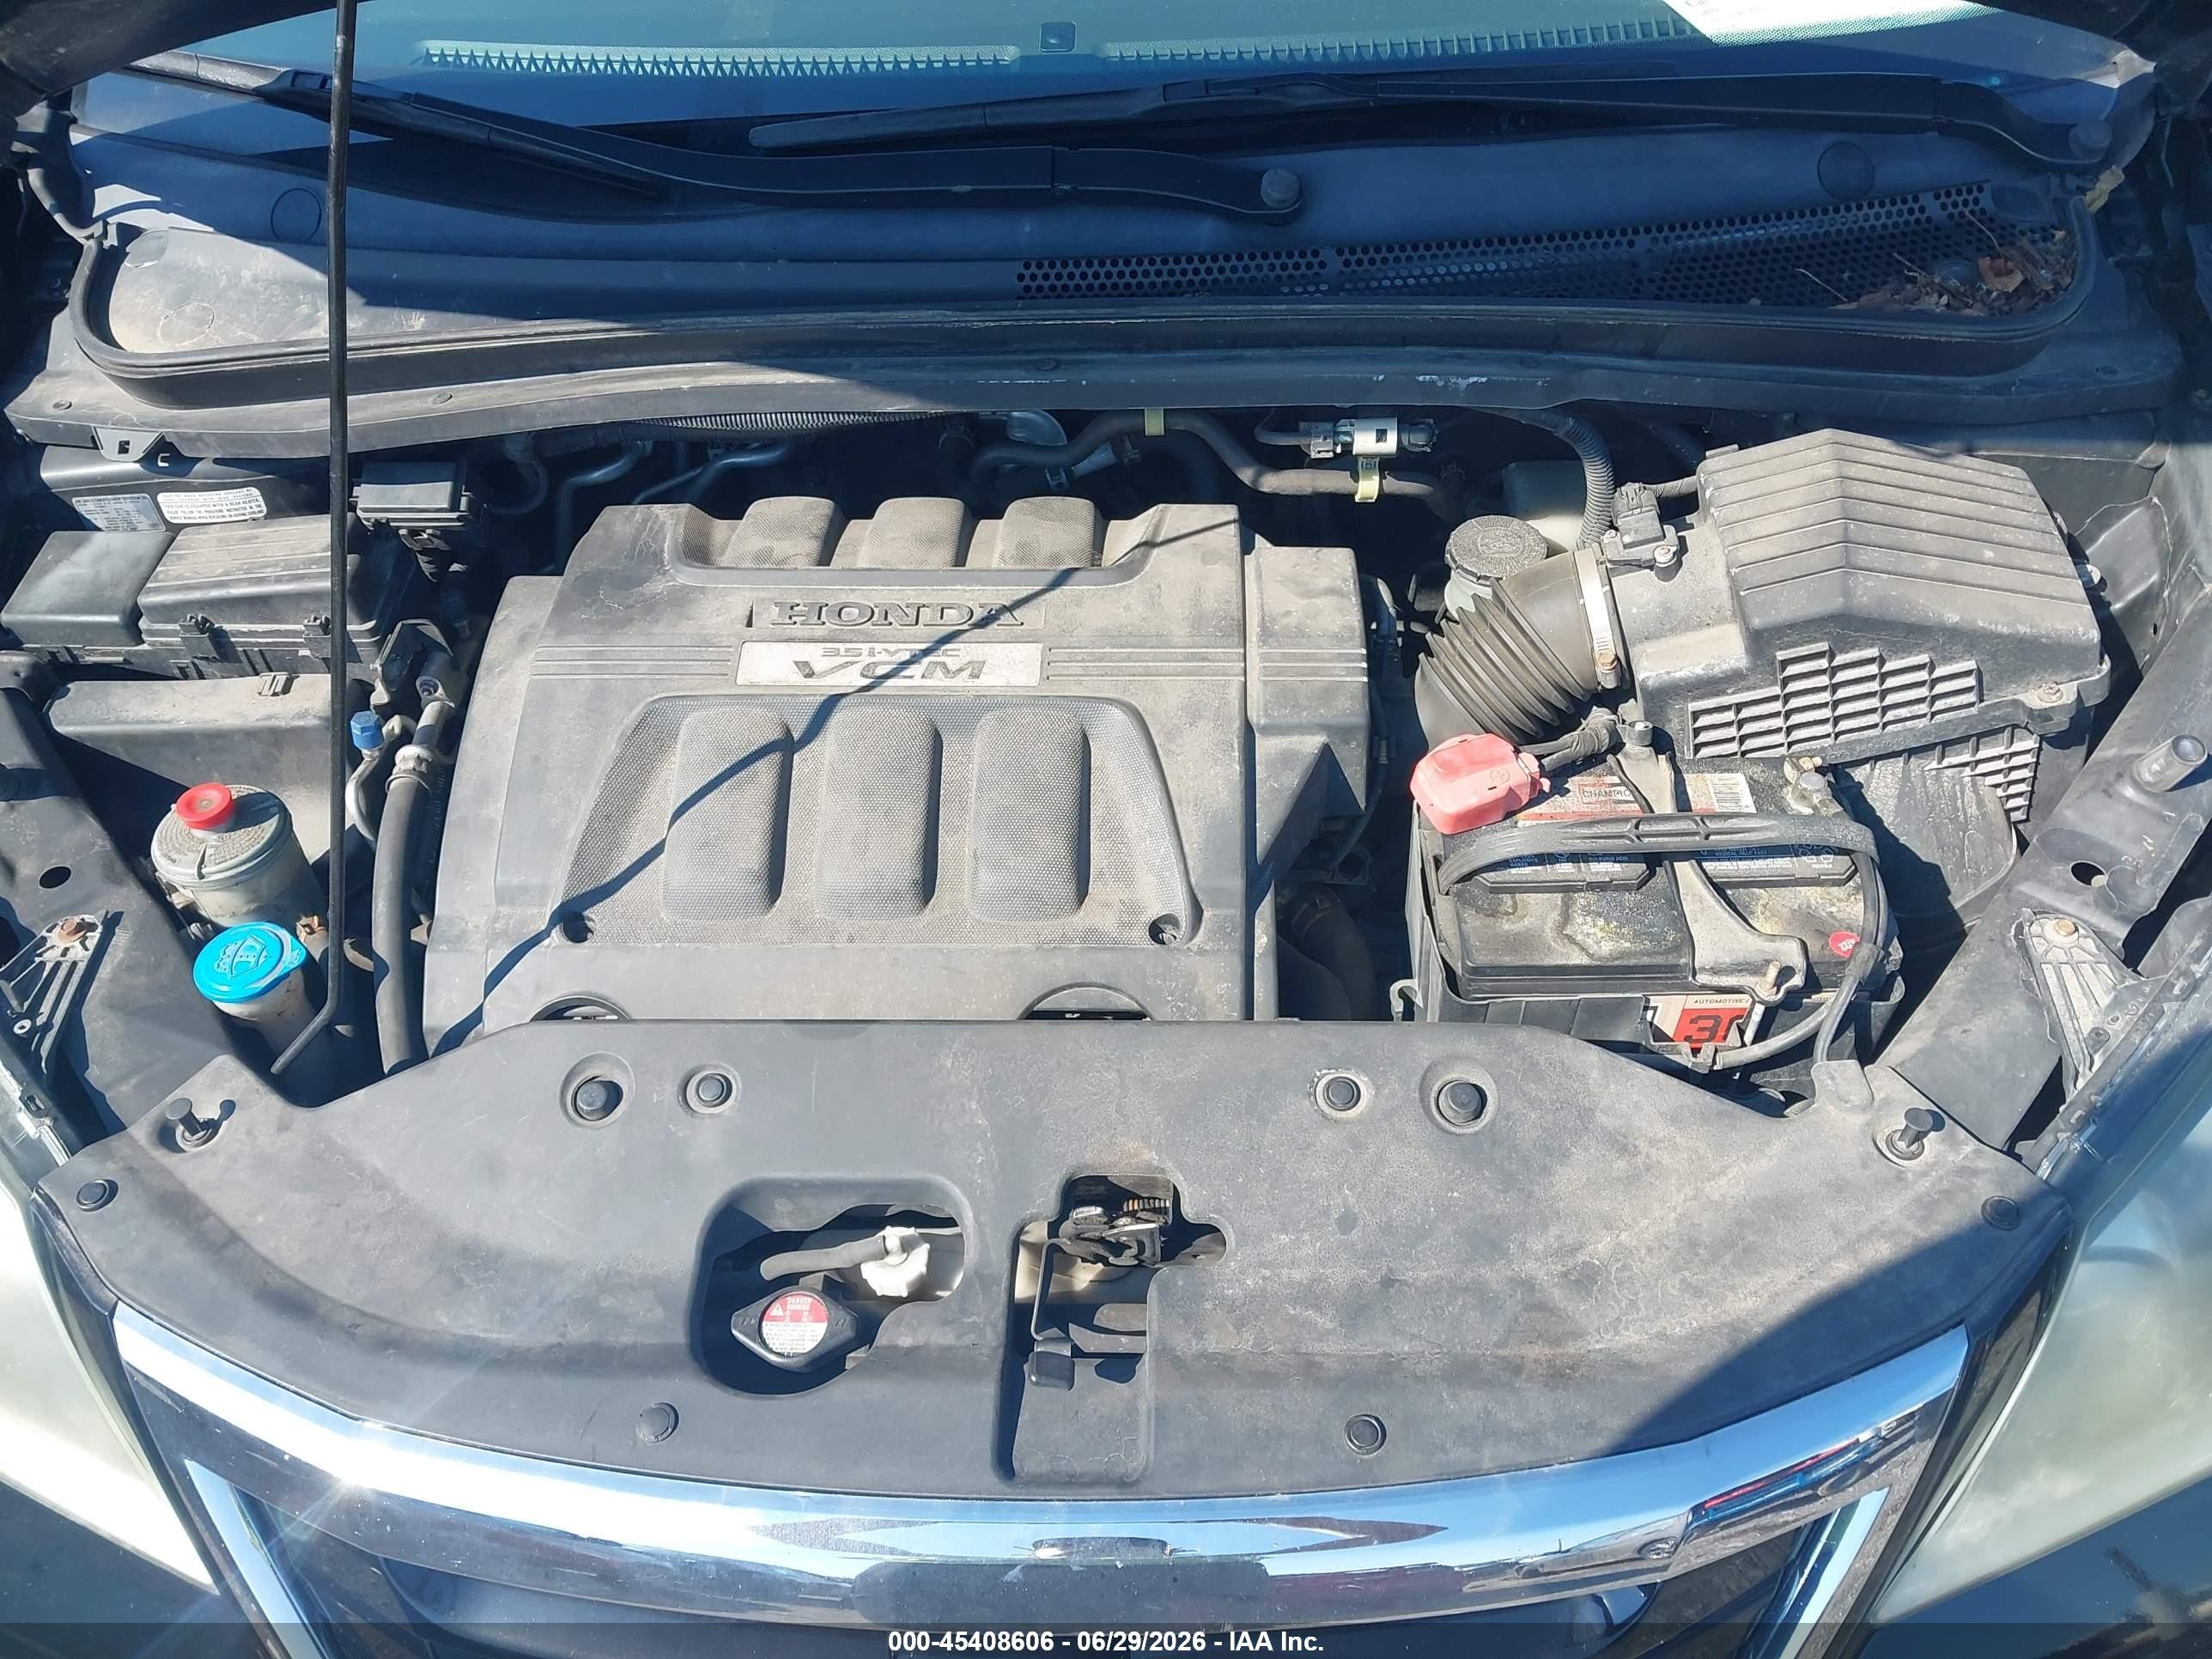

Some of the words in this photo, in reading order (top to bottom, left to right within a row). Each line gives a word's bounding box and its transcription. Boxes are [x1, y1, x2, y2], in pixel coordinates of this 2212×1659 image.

[770, 601, 1024, 628] HONDA
[793, 660, 986, 680] VCM
[1582, 788, 1632, 798] CHAMPIO
